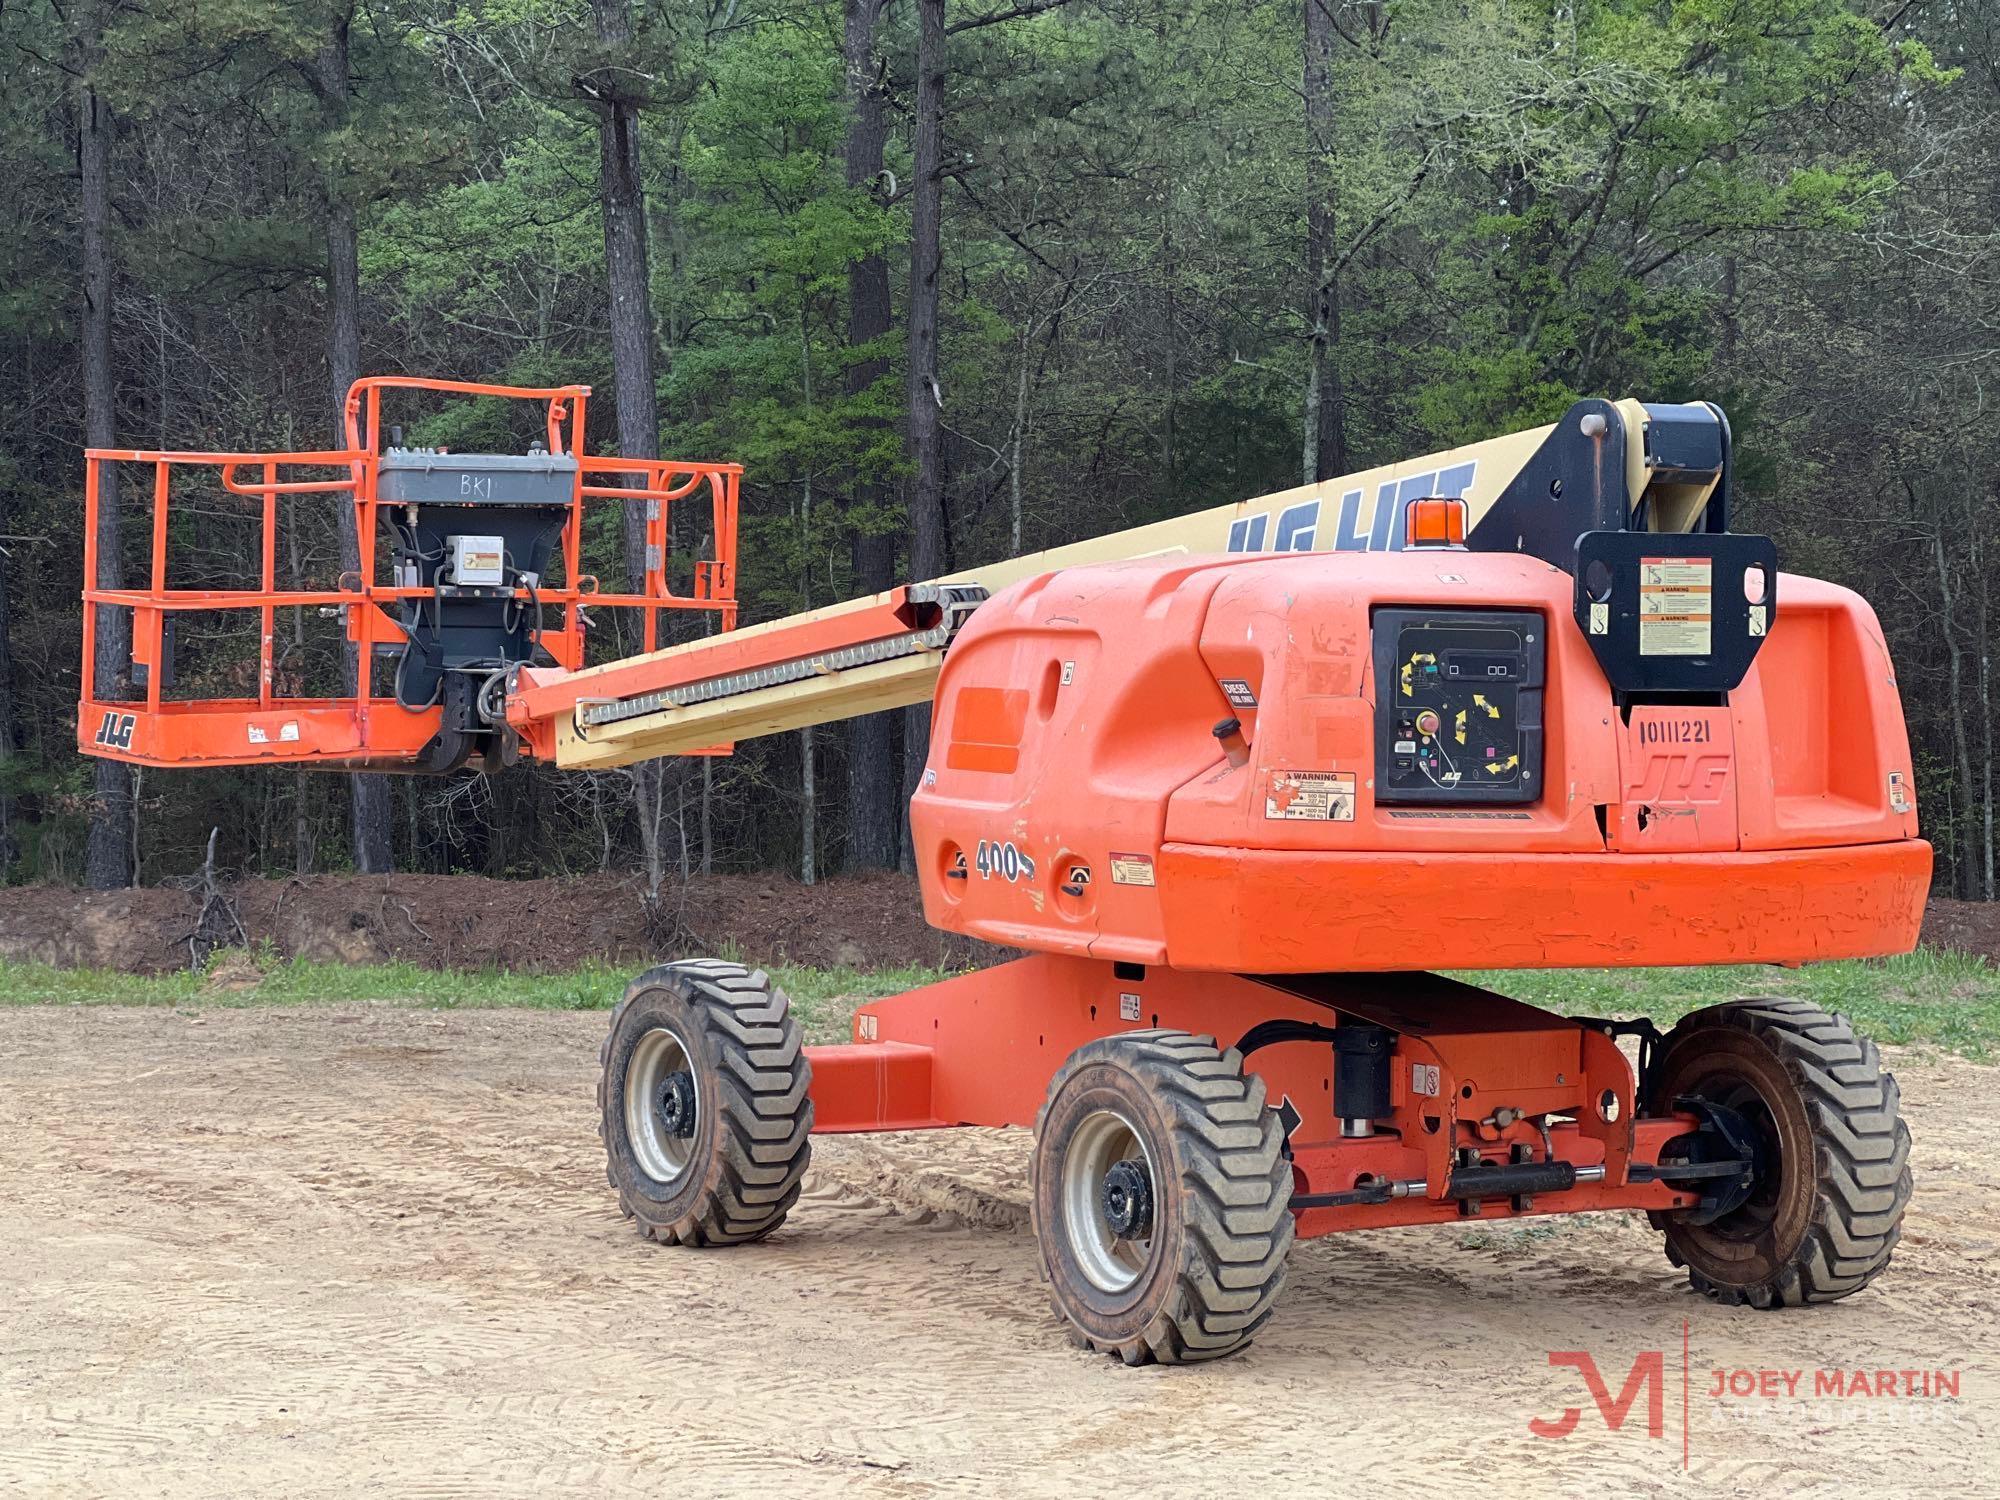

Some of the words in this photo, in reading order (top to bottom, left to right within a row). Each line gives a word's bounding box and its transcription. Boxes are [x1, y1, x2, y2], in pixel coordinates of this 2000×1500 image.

[1223, 683, 1251, 694] DIESEL
[1230, 695, 1242, 703] FUEL
[95, 711, 137, 749] JLG
[1293, 773, 1337, 781] WARNING
[1441, 771, 1462, 781] JLG
[1626, 754, 1731, 804] JLG
